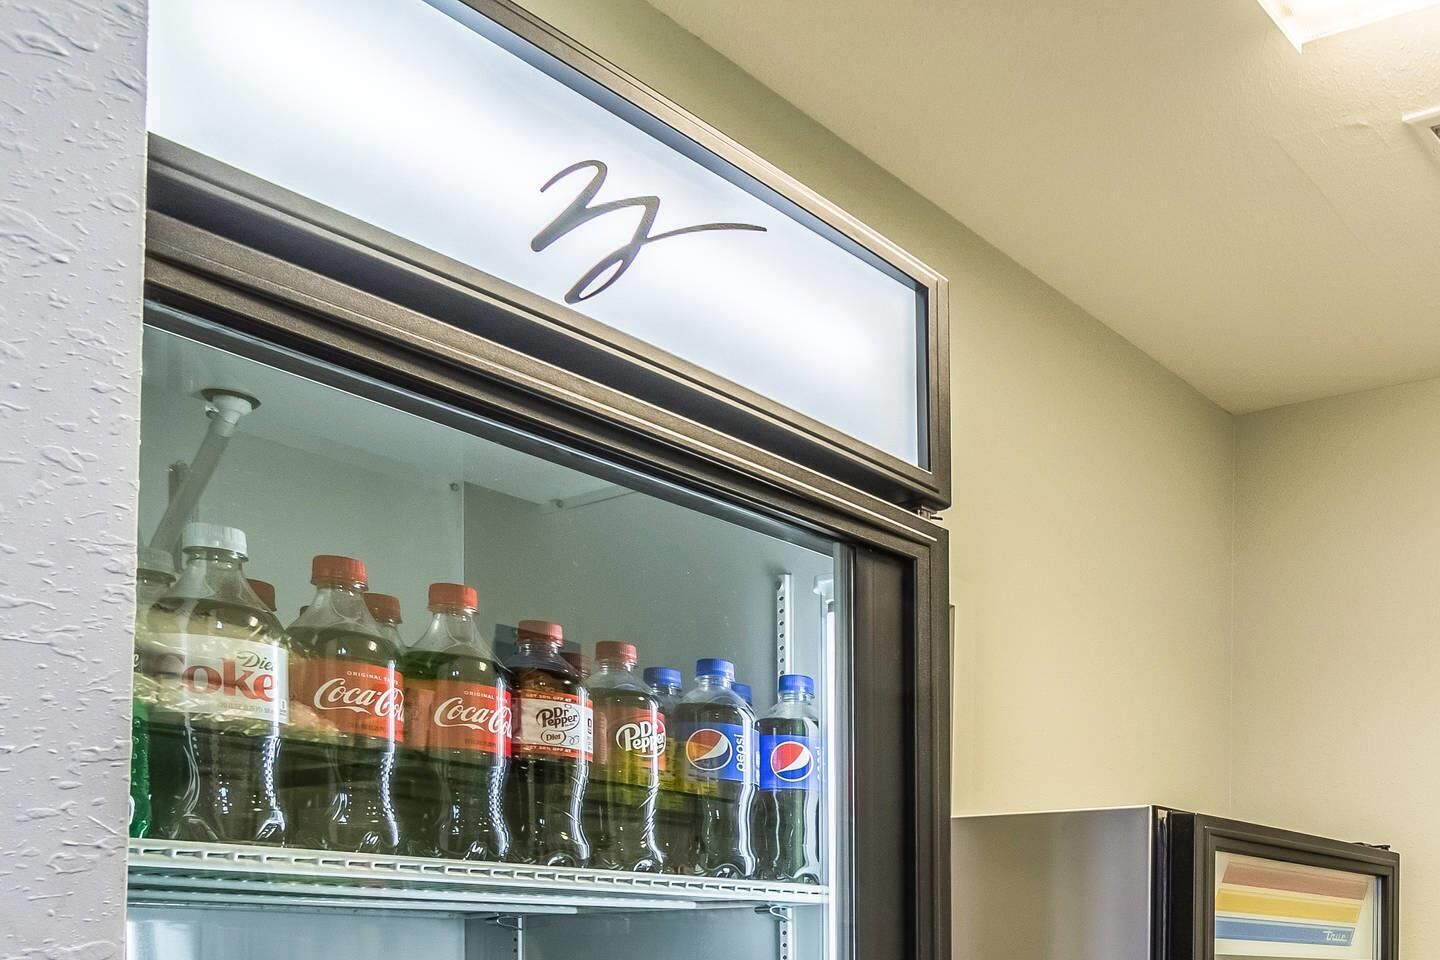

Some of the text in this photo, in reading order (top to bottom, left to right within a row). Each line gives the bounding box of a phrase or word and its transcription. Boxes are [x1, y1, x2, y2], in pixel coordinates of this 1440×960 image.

[237, 650, 274, 671] Die
[182, 656, 274, 703] oke
[536, 708, 578, 729] Pepper
[553, 706, 569, 718] Dr
